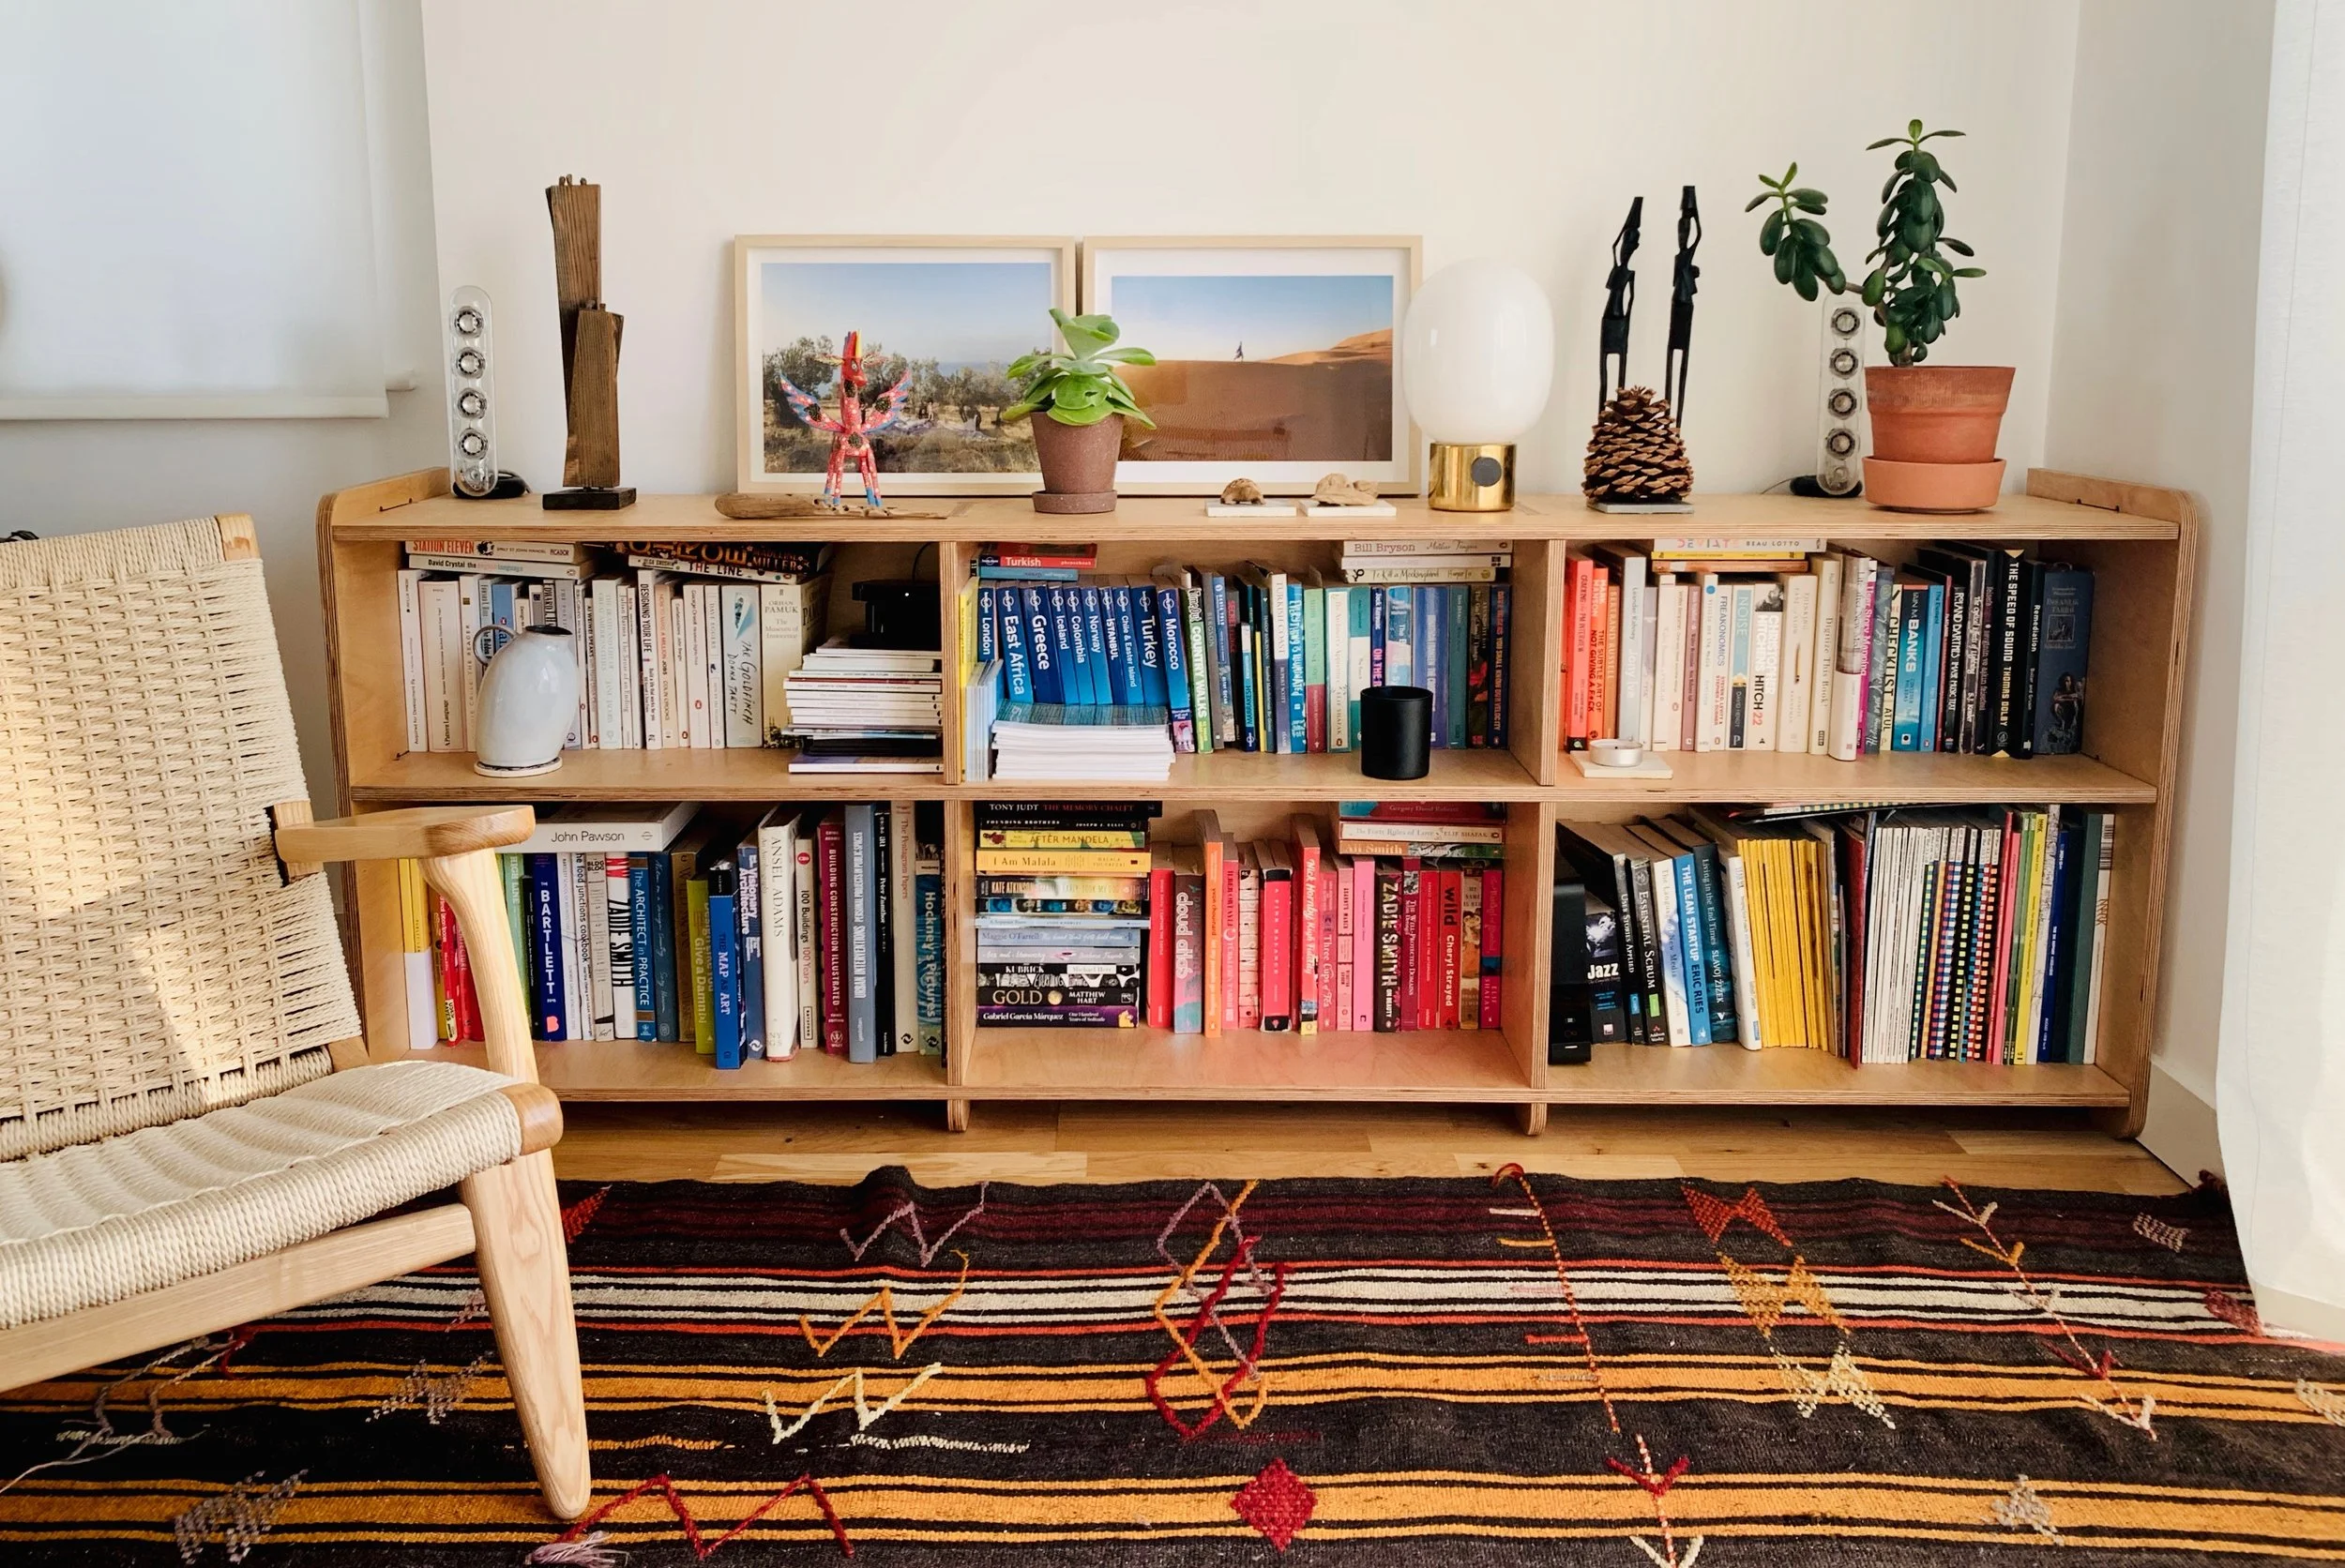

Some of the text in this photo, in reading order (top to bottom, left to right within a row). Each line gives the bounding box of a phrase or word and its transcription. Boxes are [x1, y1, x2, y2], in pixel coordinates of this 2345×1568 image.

[428, 559, 445, 567] David
[446, 561, 465, 570] Crystal
[1005, 556, 1041, 567] Turkish
[1354, 544, 1373, 553] Bill
[1377, 543, 1416, 554] Bryson
[689, 563, 744, 578] THE LINE
[640, 583, 654, 653] DESIGNING YOUR LIFE
[1057, 615, 1069, 650] Iceland
[1088, 615, 1101, 654] Norway
[1122, 615, 1130, 634] Chile
[1607, 591, 1617, 680] BERTRAND RUSSELL
[1717, 596, 1728, 667] FREAKONOMICS
[1735, 596, 1749, 637] NOISE
[1823, 617, 1834, 654] Digitize
[1860, 584, 1874, 676] User Story Mapping
[2030, 604, 2042, 653] Remediation
[982, 617, 992, 656] London
[1004, 615, 1026, 695] East Africa
[1032, 615, 1050, 671] Greece
[1071, 615, 1086, 663] Colombia
[1106, 618, 1119, 661] ISTANBUL
[1125, 641, 1134, 664] Easter
[1141, 614, 1158, 669] Turkey
[1165, 617, 1180, 671] Morocco
[1190, 626, 1204, 676] COUNTRY
[1754, 614, 1768, 672] HITCHENS
[1765, 614, 1780, 695] CHRISTOPHER
[1905, 619, 1919, 673] BANKS
[1999, 563, 2020, 727] THE SPEED OF SOUND THOMAS DOLBY
[1373, 648, 1383, 681] ON THE
[1822, 657, 1831, 677] This
[1883, 616, 1899, 697] CHECKLIST
[726, 654, 740, 715] DONNA TARTT
[739, 661, 758, 726] GOLDFINCH
[1127, 666, 1137, 688] Island
[1195, 679, 1207, 718] WALKS
[1245, 685, 1253, 725] MARRAKESH
[1596, 701, 1603, 713] OF
[1752, 674, 1764, 726] HITCH 22
[1884, 708, 1892, 731] ATUL
[1389, 805, 1414, 813] Gregory
[552, 830, 625, 842] John Pawson
[1030, 834, 1110, 844] AFTER MANDELA
[577, 865, 586, 883] food
[1001, 858, 1018, 867] Am
[1021, 857, 1056, 867] Malala
[1702, 858, 1713, 883] Living
[576, 884, 587, 923] junctions
[738, 867, 751, 935] Architecture
[747, 867, 759, 919] Visionary
[769, 836, 785, 938] ANSEL ADAMS
[1381, 882, 1399, 929] ZADIE
[1408, 899, 1416, 912] THE
[1443, 886, 1459, 927] wild
[1705, 892, 1715, 905] the
[828, 849, 840, 1006] BUILDING CONSTRUCTION ILLUSTRATED
[1210, 904, 1218, 936] chouinard
[1620, 893, 1635, 973] USER STORIES APPLIED
[1706, 906, 1716, 922] End
[540, 889, 554, 995] BARTLETT
[580, 925, 590, 963] cookbook
[608, 898, 635, 988] ZADIE SMITH
[634, 870, 650, 1006] The ARCHITECT in PRACTICE
[799, 889, 811, 985] 100 Buildings 100 Years
[981, 931, 1007, 942] Maggie
[1175, 892, 1193, 979] cloud atlas
[1323, 935, 1332, 961] Three
[1407, 914, 1417, 967] WELL-PROTECTED
[1638, 890, 1657, 989] ESSENTIAL SCRUM
[1681, 865, 1704, 1014] THE LEAN STARTUP ERIC RIES
[1708, 923, 1717, 945] Times
[719, 952, 730, 978] MAP
[921, 891, 938, 1018] Hockney's Pictures
[1006, 965, 1045, 973] KUBRICK
[1321, 963, 1334, 984] Cups
[1381, 933, 1399, 987] SMITH
[1444, 934, 1455, 1006] Cheryl Strayed
[1587, 962, 1620, 980] Jazz
[1711, 949, 1722, 978] SLAVOJ
[694, 937, 707, 1012] Give a Damn
[1385, 988, 1392, 997] ON
[1713, 979, 1725, 1003] ŽIŽEK
[719, 993, 732, 1015] ART
[992, 989, 1043, 1004] GOLD
[1322, 992, 1332, 1008] Tea
[1009, 1012, 1033, 1020] García
[1034, 1012, 1064, 1022] Márquez
